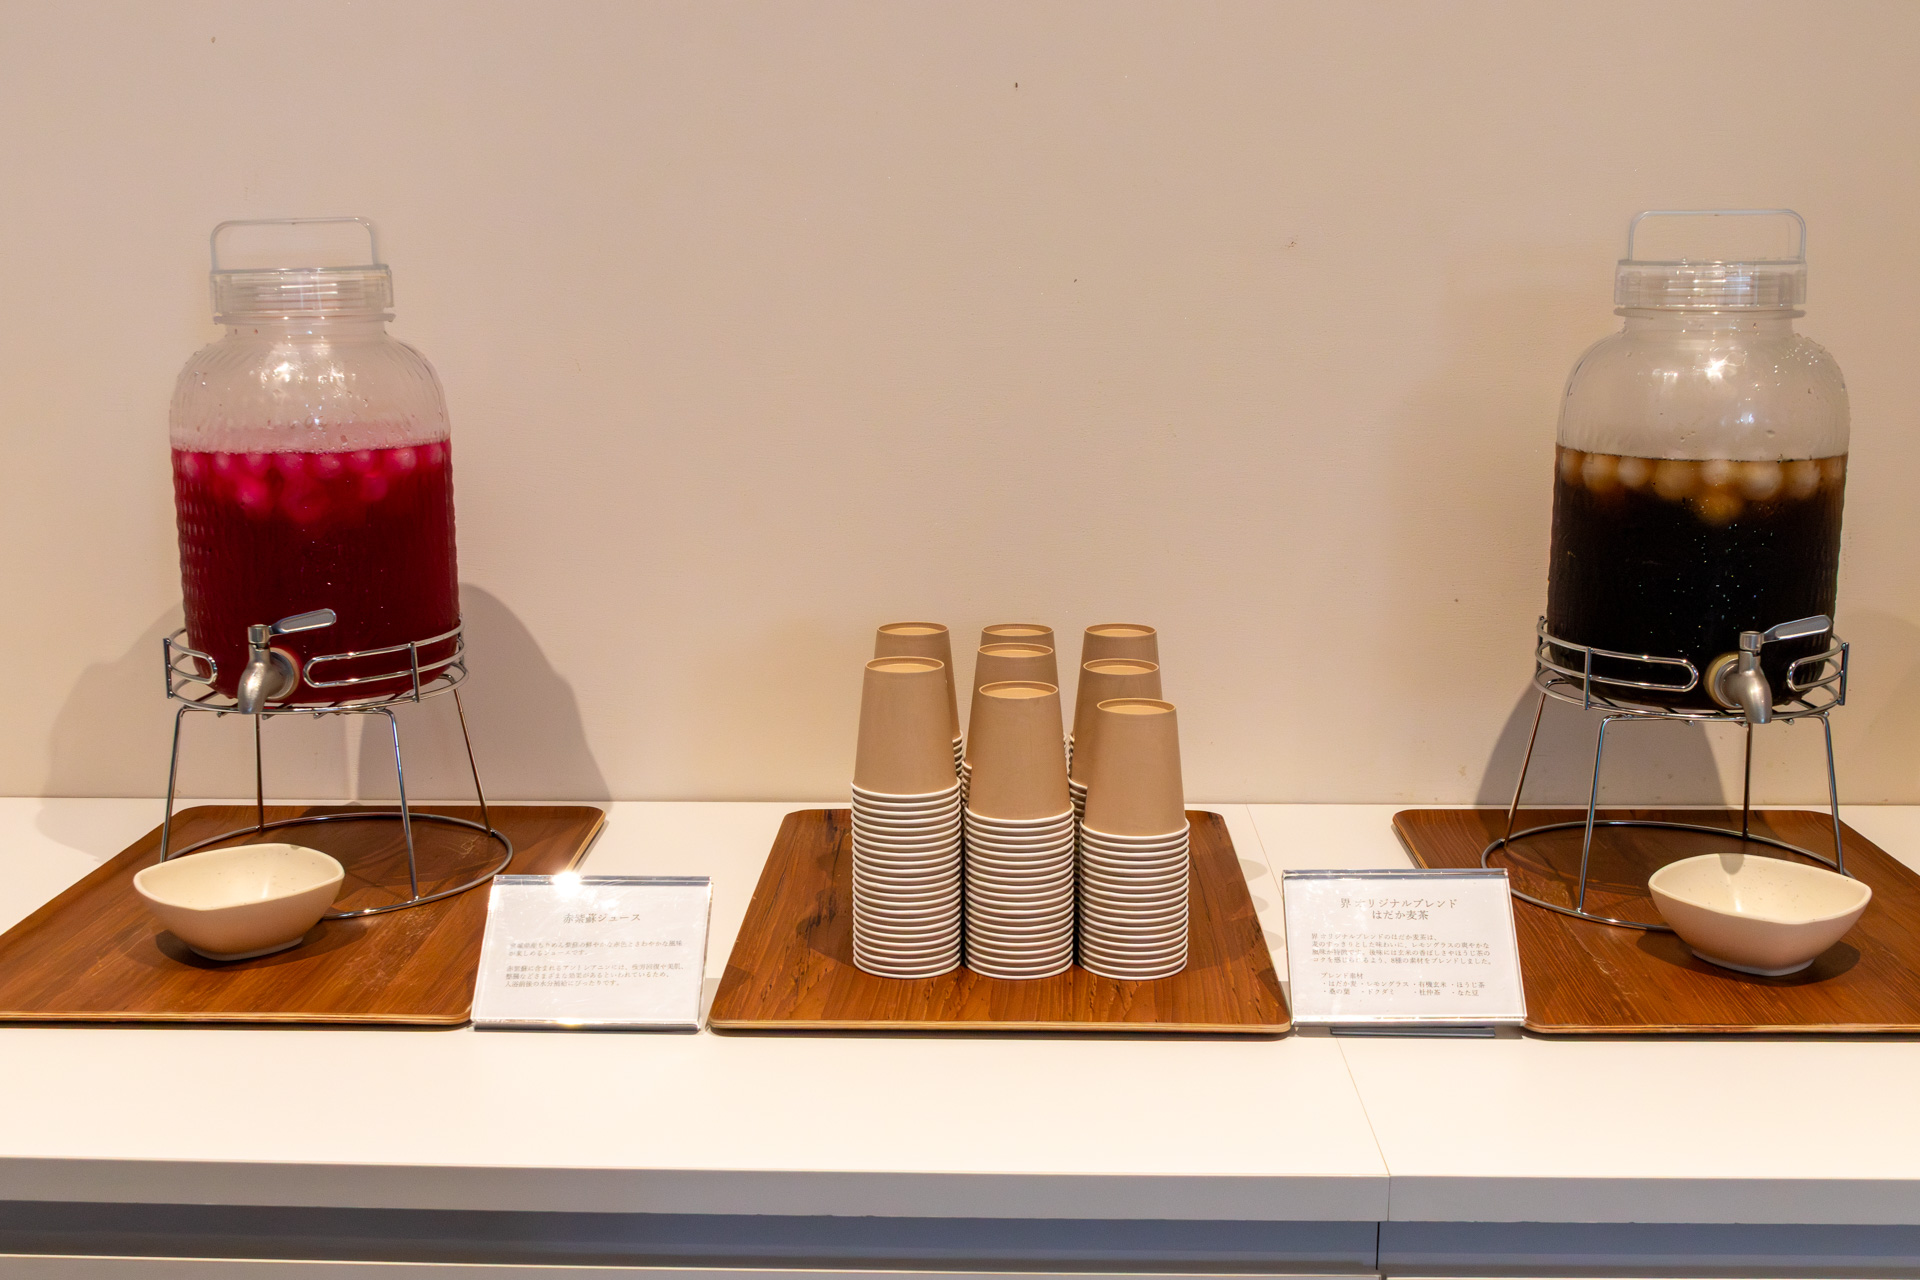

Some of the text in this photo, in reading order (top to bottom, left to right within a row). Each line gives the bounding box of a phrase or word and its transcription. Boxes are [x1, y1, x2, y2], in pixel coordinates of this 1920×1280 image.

[563, 912, 641, 924] 赤紫蘇ジュース
[1372, 909, 1429, 921] はだか麦茶
[1321, 972, 1363, 980] ブレンド素材
